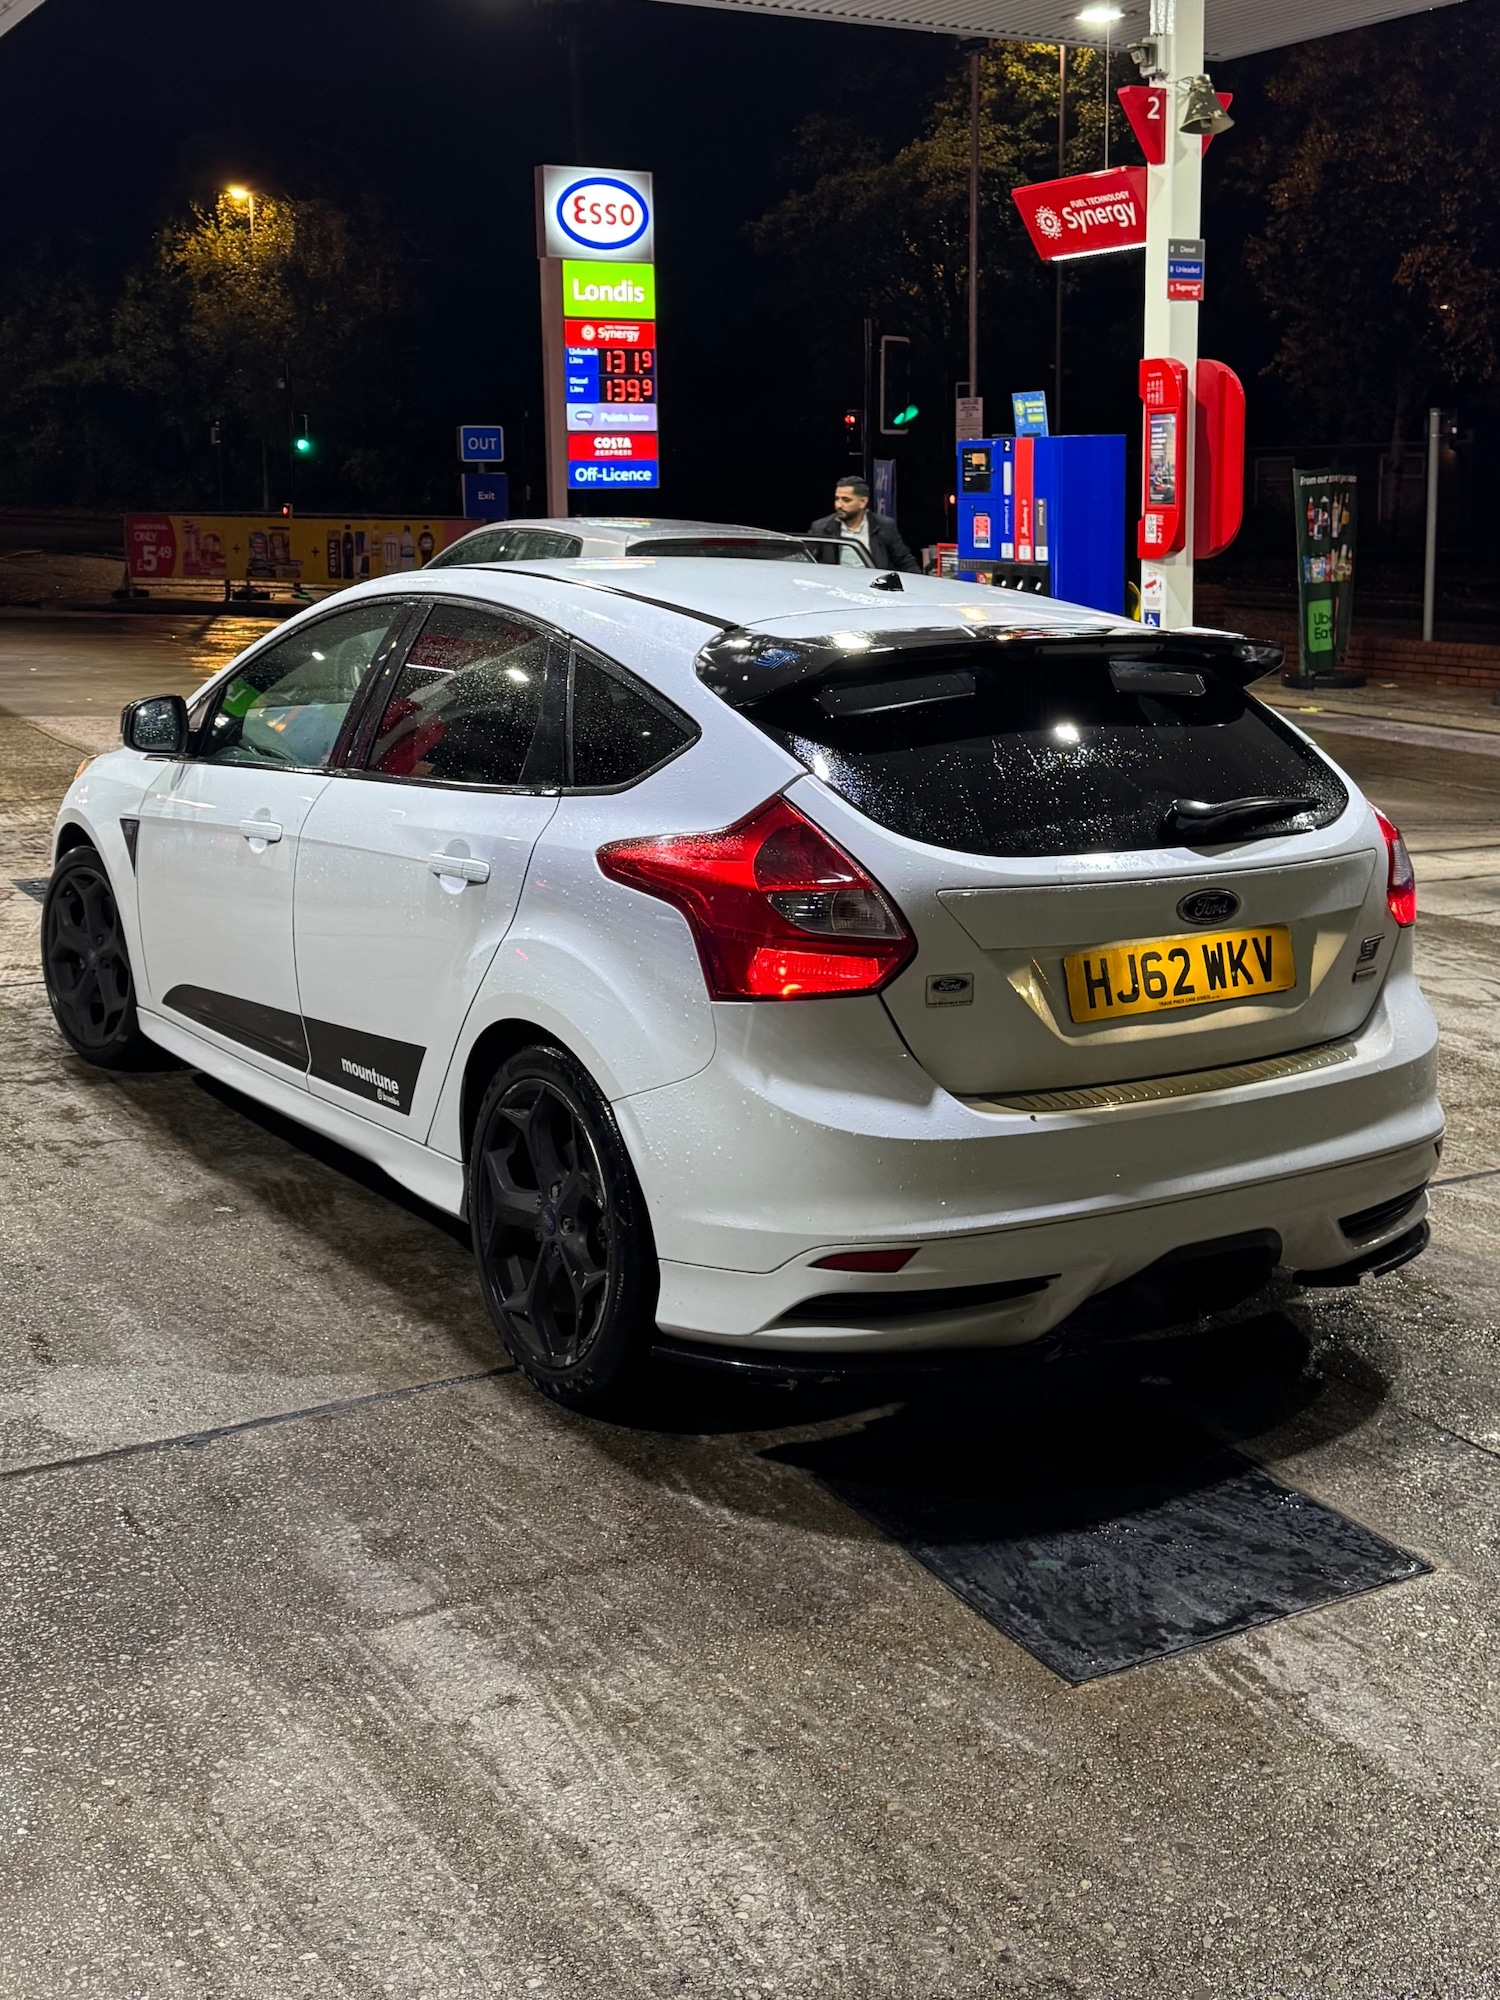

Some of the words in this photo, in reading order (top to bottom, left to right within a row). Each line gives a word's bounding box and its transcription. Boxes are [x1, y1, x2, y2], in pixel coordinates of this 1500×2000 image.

[1147, 96, 1161, 120] 2
[1069, 199, 1088, 209] FUEL
[1085, 190, 1130, 206] TECHNOLOGY
[1061, 201, 1137, 234] Synergy
[1175, 265, 1201, 274] Unleaded
[572, 277, 645, 303] Londis
[597, 327, 640, 342] Synergy
[606, 350, 653, 374] 131.9
[606, 379, 653, 402] 139.9
[467, 437, 498, 451] OUT
[593, 437, 632, 449] COSTA
[1004, 440, 1011, 452] 2
[575, 467, 652, 482] Off-Licence
[477, 491, 496, 500] Exit
[134, 531, 157, 542] ONLY
[1194, 896, 1228, 917] Ford
[1083, 947, 1195, 1009] HJ62
[1201, 935, 1273, 991] WKV
[938, 979, 962, 991] Ford
[341, 1058, 399, 1094] mountune
